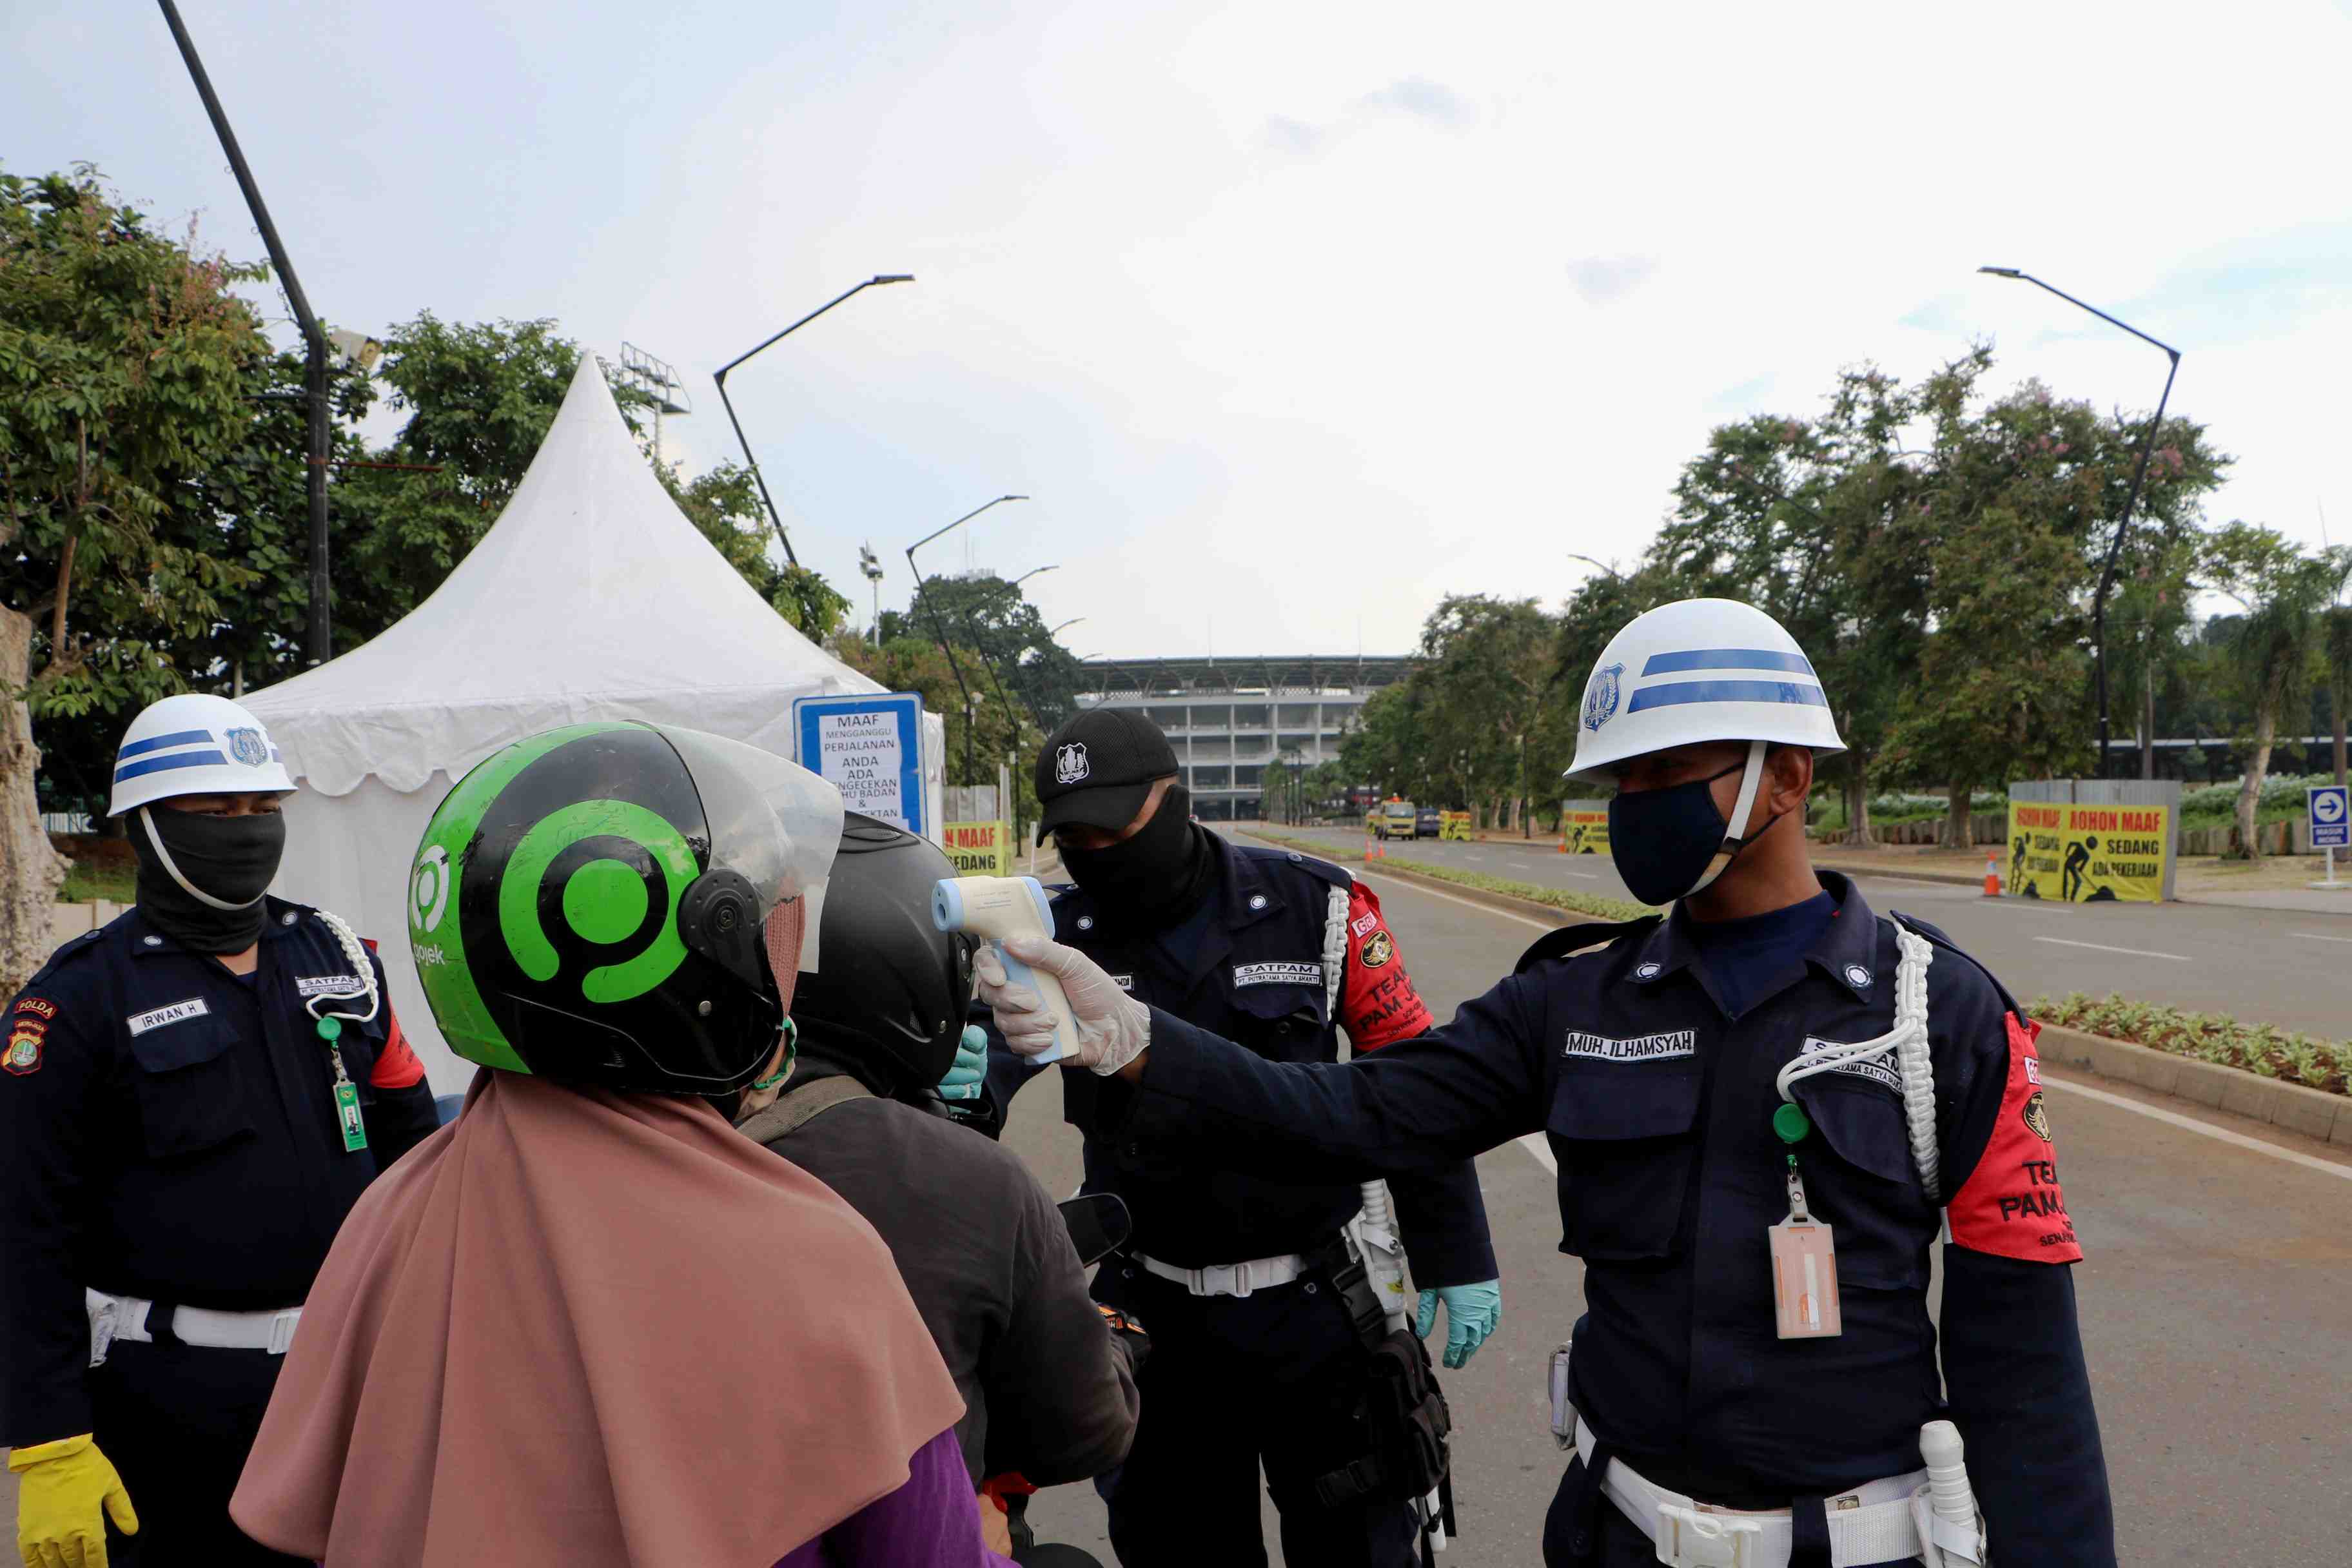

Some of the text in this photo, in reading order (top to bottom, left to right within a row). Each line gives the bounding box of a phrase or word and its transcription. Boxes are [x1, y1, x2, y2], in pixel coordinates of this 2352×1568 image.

[838, 714, 879, 727] MAAF
[825, 728, 892, 739] MENGGANGGU
[825, 740, 894, 752] PERJALANAN
[842, 756, 879, 767] ANDA
[847, 769, 874, 779] ADA
[832, 779, 897, 790] NGECEKAN
[859, 789, 896, 798] BADAN
[858, 799, 866, 808] &
[2122, 812, 2161, 832] MAAF
[958, 827, 995, 847] MAAF
[2107, 839, 2159, 855] SEDANG
[950, 855, 996, 870] EDANG
[413, 943, 445, 966] gojek
[1244, 965, 1313, 974] SATPAM
[19, 1000, 53, 1017] POLDA
[142, 1003, 197, 1028] IRWAN H
[2022, 1160, 2058, 1186] TE
